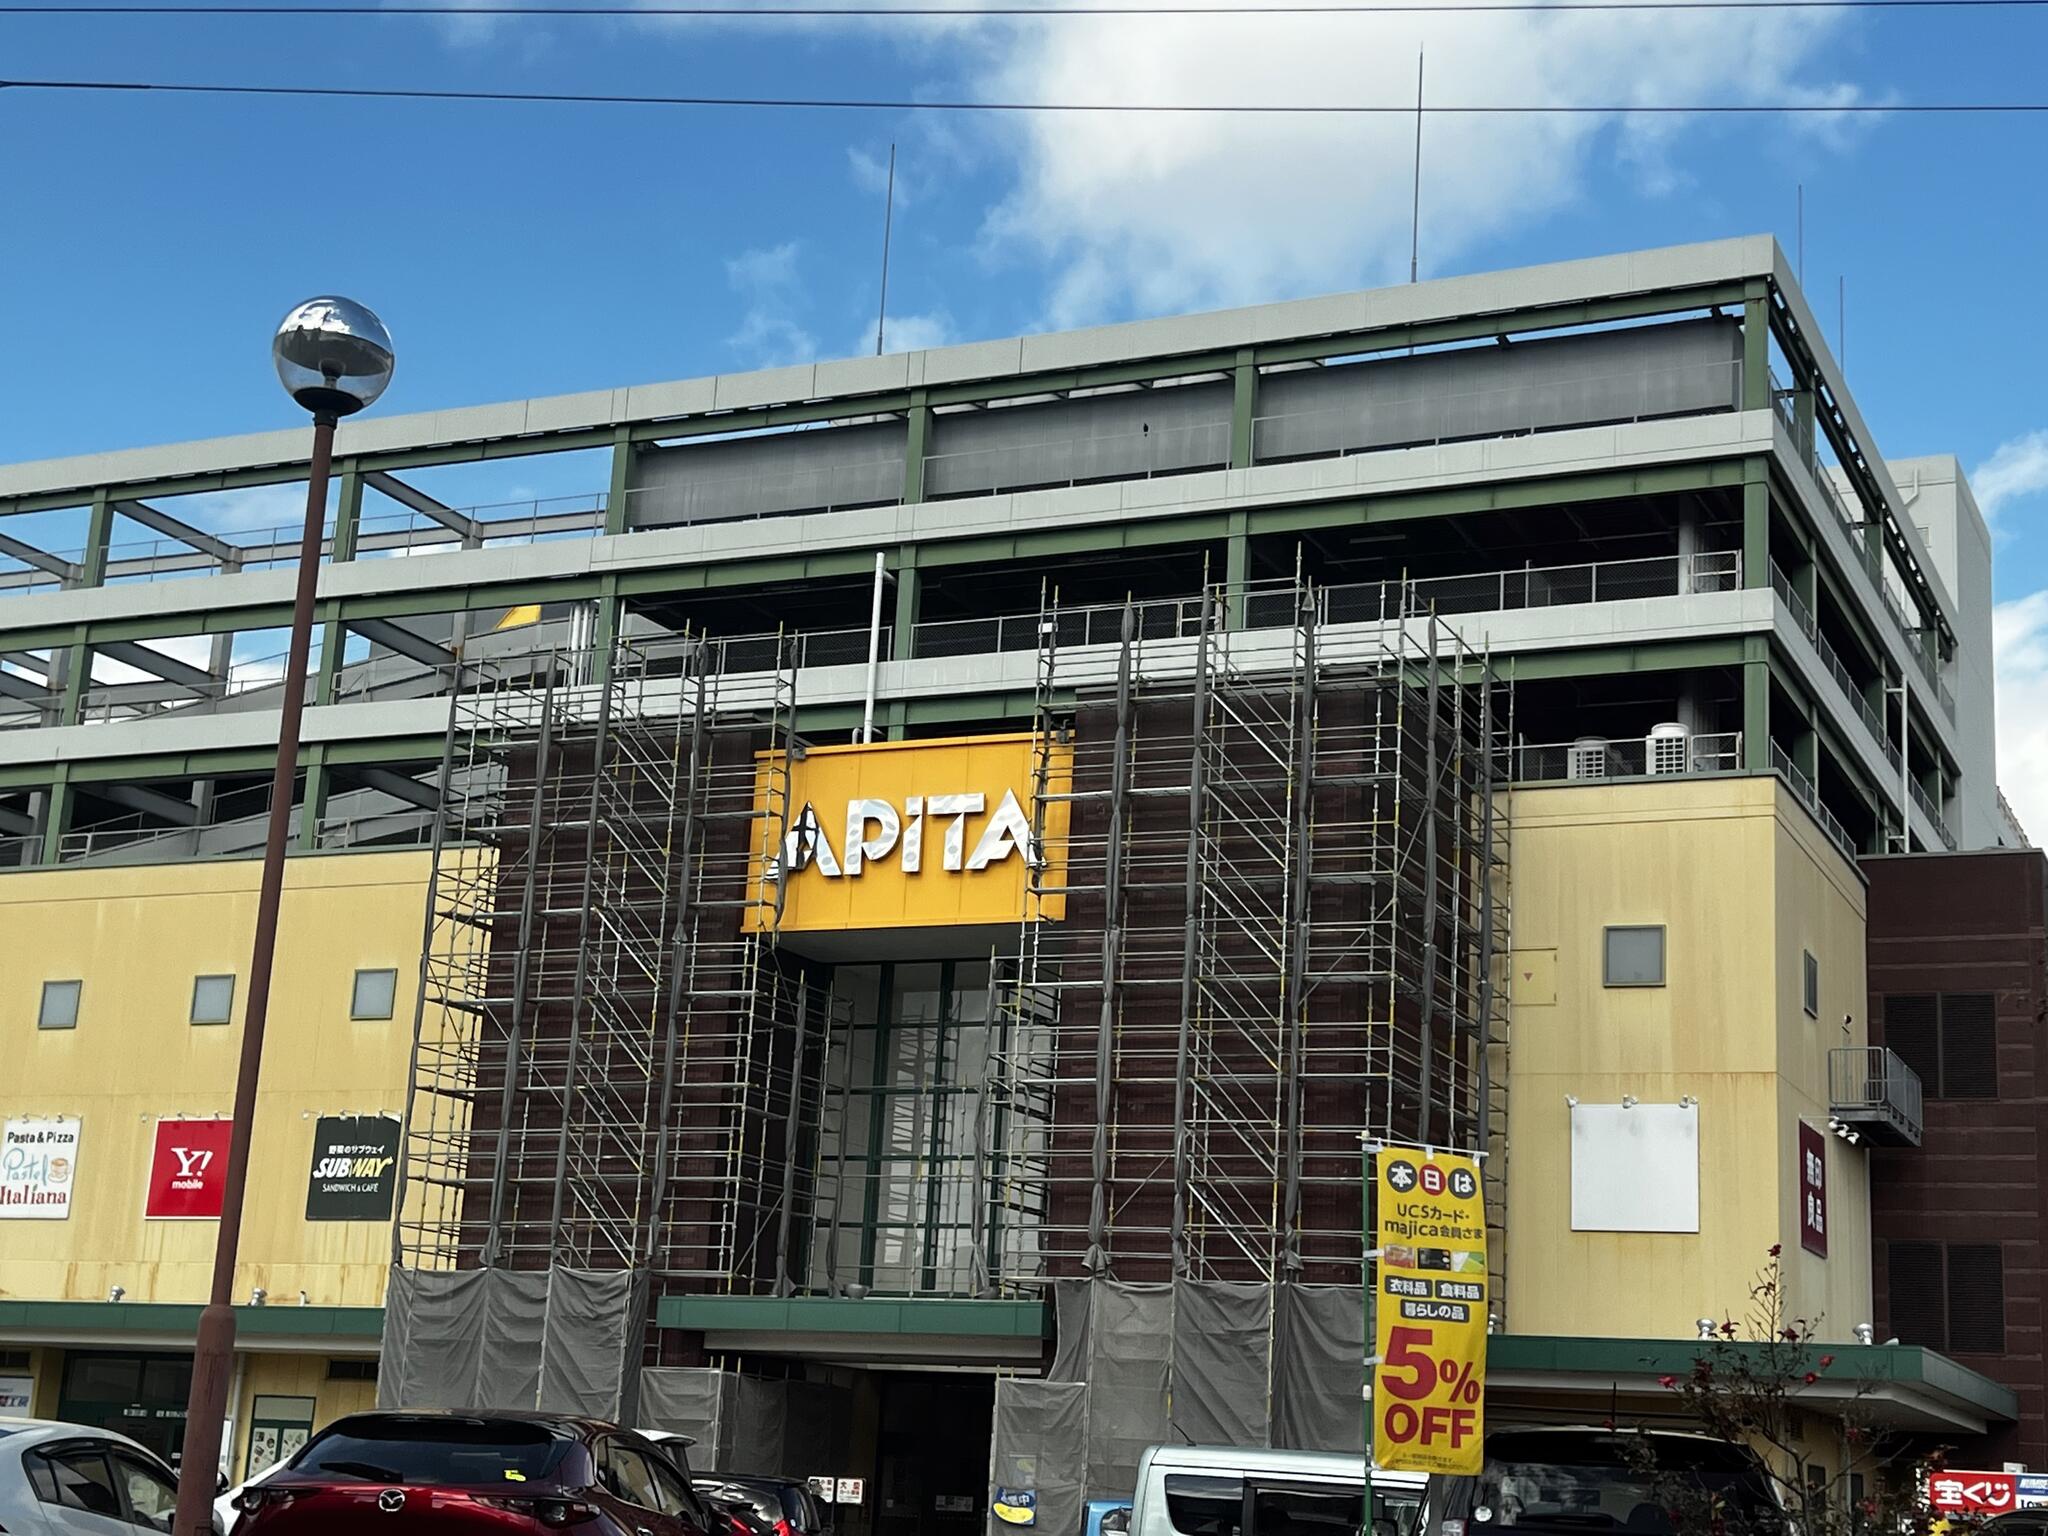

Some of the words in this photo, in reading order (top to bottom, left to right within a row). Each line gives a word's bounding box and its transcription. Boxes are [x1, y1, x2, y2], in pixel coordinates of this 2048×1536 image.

[765, 787, 1046, 880] APITA
[7, 1131, 35, 1144] Pasta
[36, 1132, 45, 1143] &
[46, 1131, 74, 1143] Pizza
[3, 1147, 49, 1186] Pastel
[170, 1147, 213, 1177] Y!
[312, 1156, 394, 1179] SUBWAY
[172, 1179, 204, 1190] mobile
[322, 1183, 356, 1193] SANDWICH
[1391, 1164, 1474, 1195] 本日は
[0, 1184, 66, 1205] Italiana
[1384, 1220, 1484, 1240] majica会員さま
[1389, 1278, 1428, 1296] 衣料品
[1439, 1282, 1481, 1300] 食料品
[1403, 1302, 1466, 1321] 暮らしの品
[1381, 1325, 1482, 1405] 5%
[1384, 1403, 1476, 1450] OFF
[1934, 1479, 2011, 1507] 宝くじ
